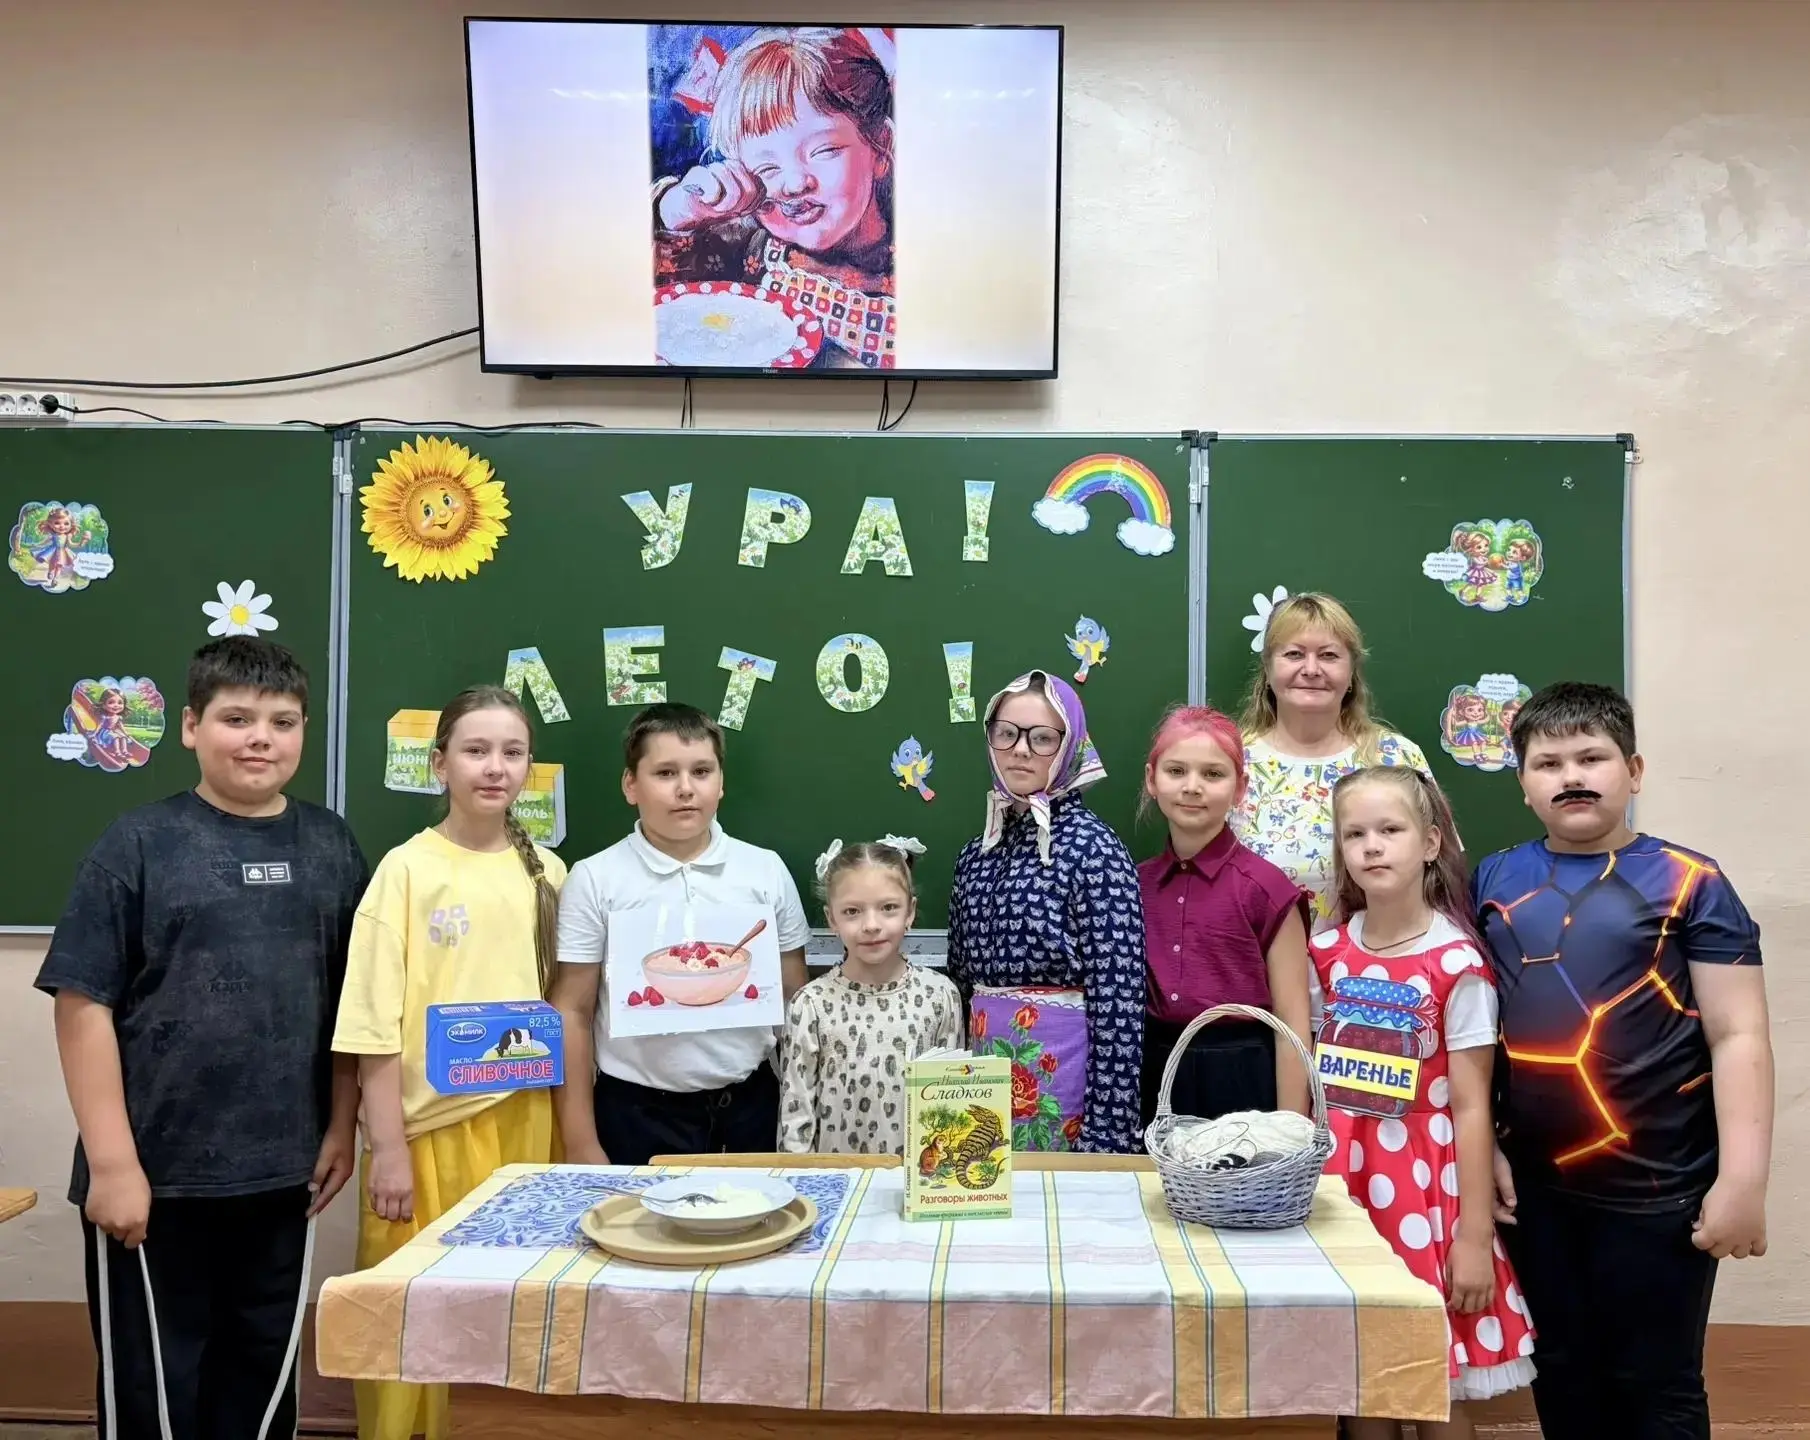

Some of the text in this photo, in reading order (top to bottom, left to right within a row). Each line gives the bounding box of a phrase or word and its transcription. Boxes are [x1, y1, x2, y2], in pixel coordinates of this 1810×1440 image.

[449, 1057, 473, 1065] МАСЛО
[449, 1060, 553, 1085] СЛИВОЧНОЕ
[1319, 1054, 1412, 1089] ВАРЕНЬЕ
[920, 1081, 993, 1101] Сладков
[920, 1193, 1008, 1205] Разговоры животных
